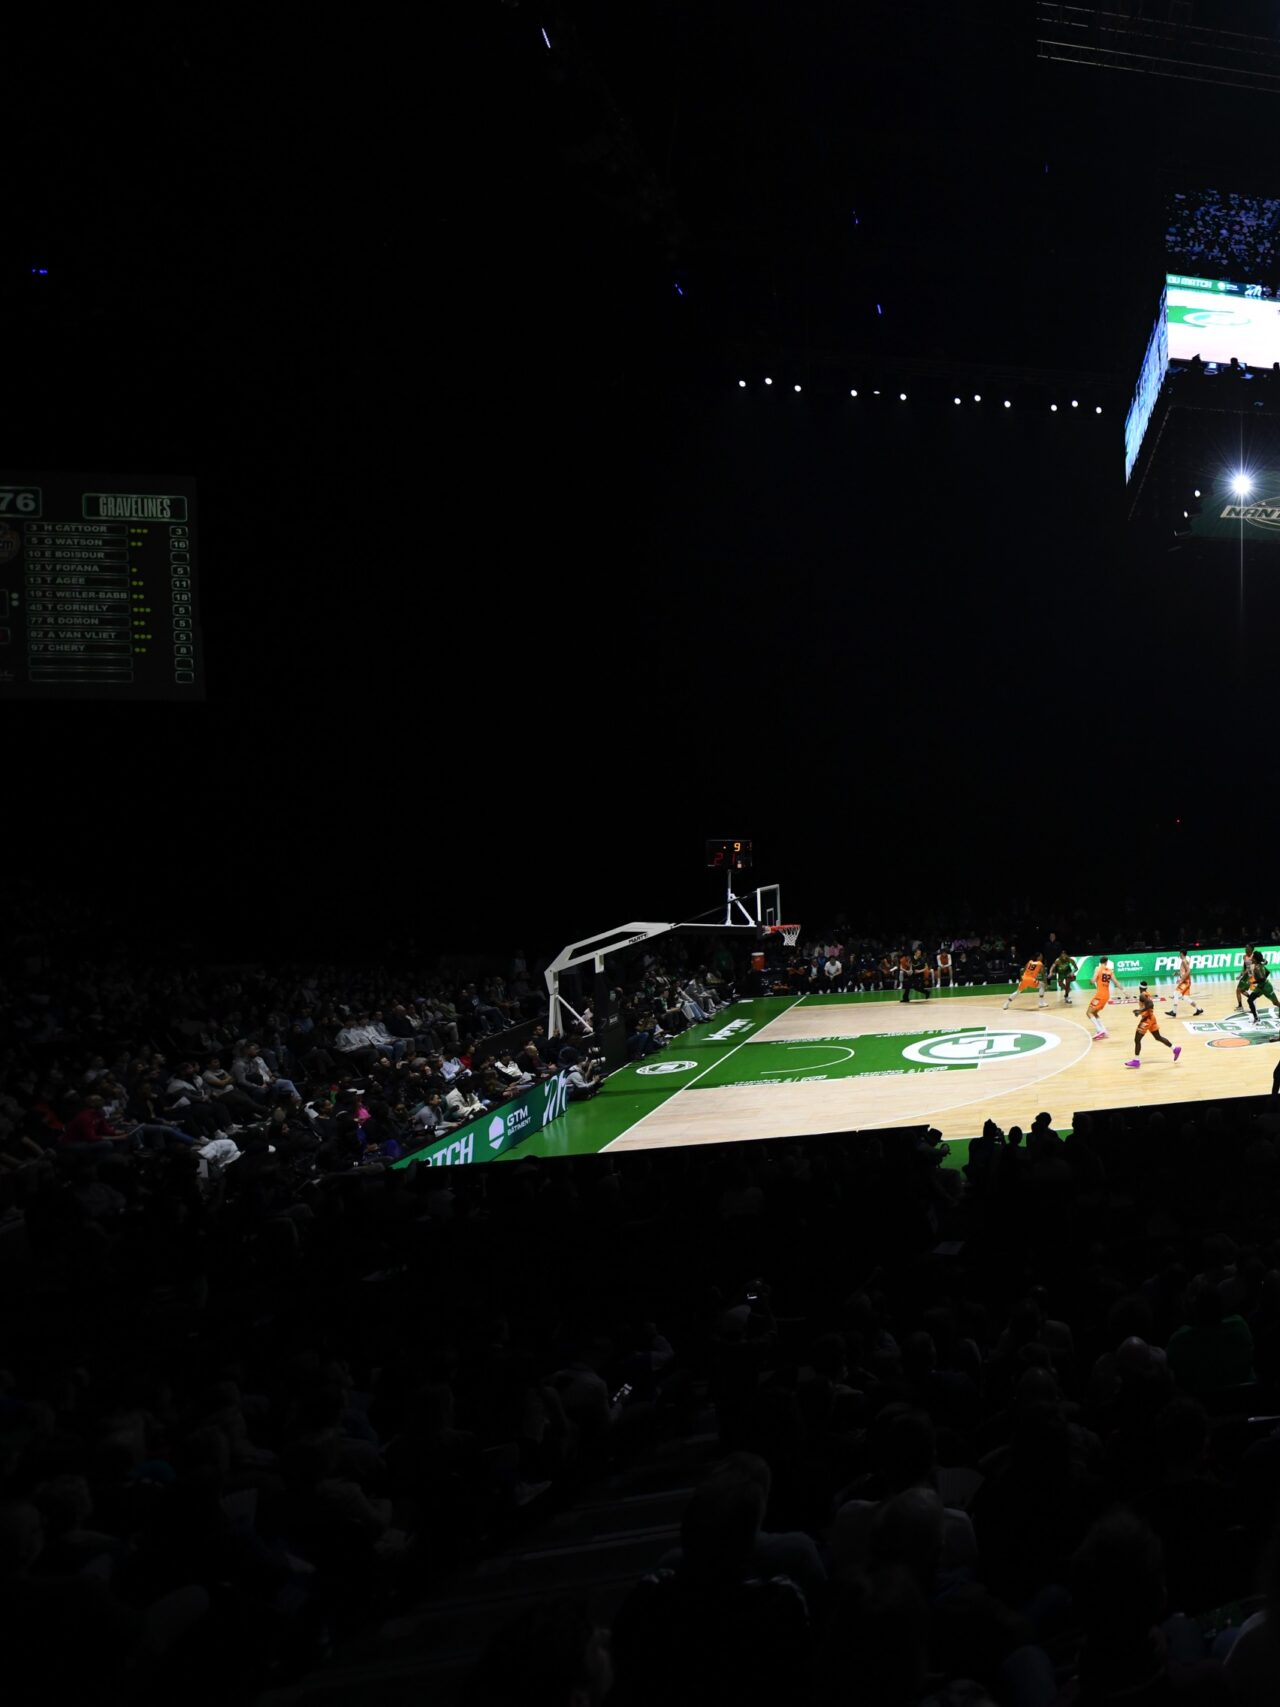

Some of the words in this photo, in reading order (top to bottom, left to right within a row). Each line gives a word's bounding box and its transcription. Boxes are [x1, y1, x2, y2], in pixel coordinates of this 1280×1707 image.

[99, 496, 172, 518] GRAVELINES
[55, 525, 107, 533] CATTOOR
[55, 538, 103, 546] WATSON
[58, 604, 109, 612] CORNELY
[60, 631, 81, 639] VAN
[84, 632, 117, 640] VLIET
[48, 644, 87, 652] CHERY
[1118, 960, 1140, 968] GTM
[1154, 953, 1232, 971] PARAIN
[506, 1105, 528, 1127] GTM
